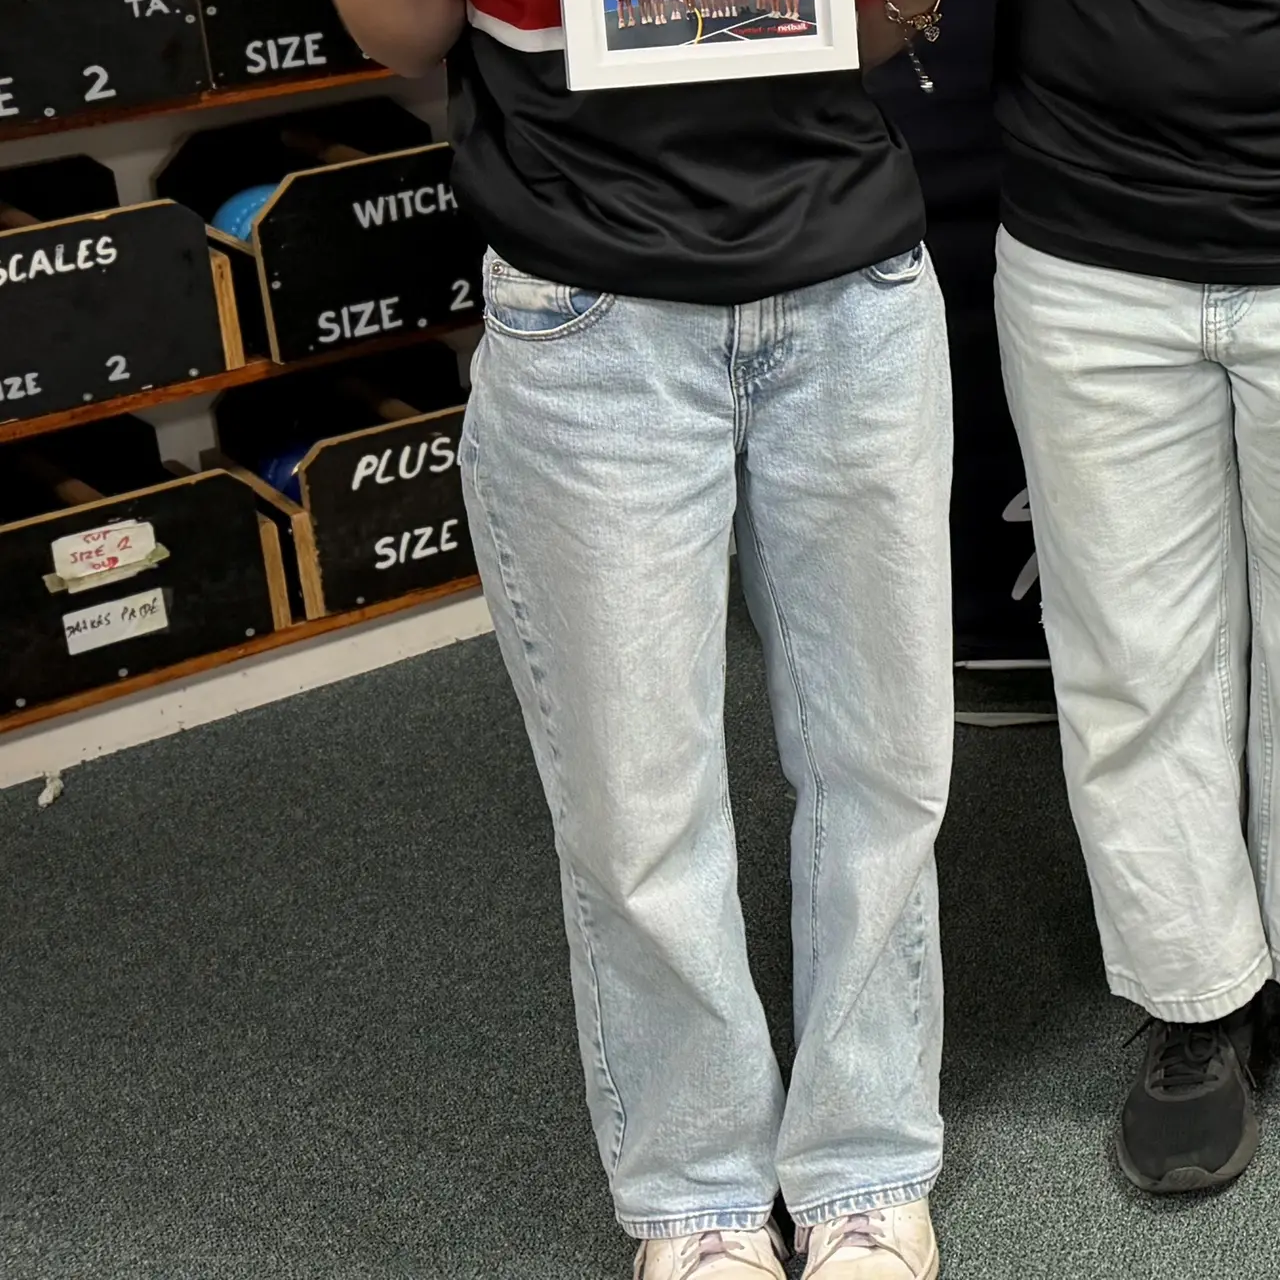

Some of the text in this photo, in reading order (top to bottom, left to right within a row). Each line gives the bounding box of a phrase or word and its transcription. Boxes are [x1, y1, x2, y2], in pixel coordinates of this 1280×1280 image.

[245, 33, 328, 75] SIZE
[82, 65, 117, 102] 2
[318, 279, 475, 344] SIZE 2
[0, 354, 132, 402] IZE 2
[117, 536, 132, 551] 2
[374, 519, 460, 570] SIZE
